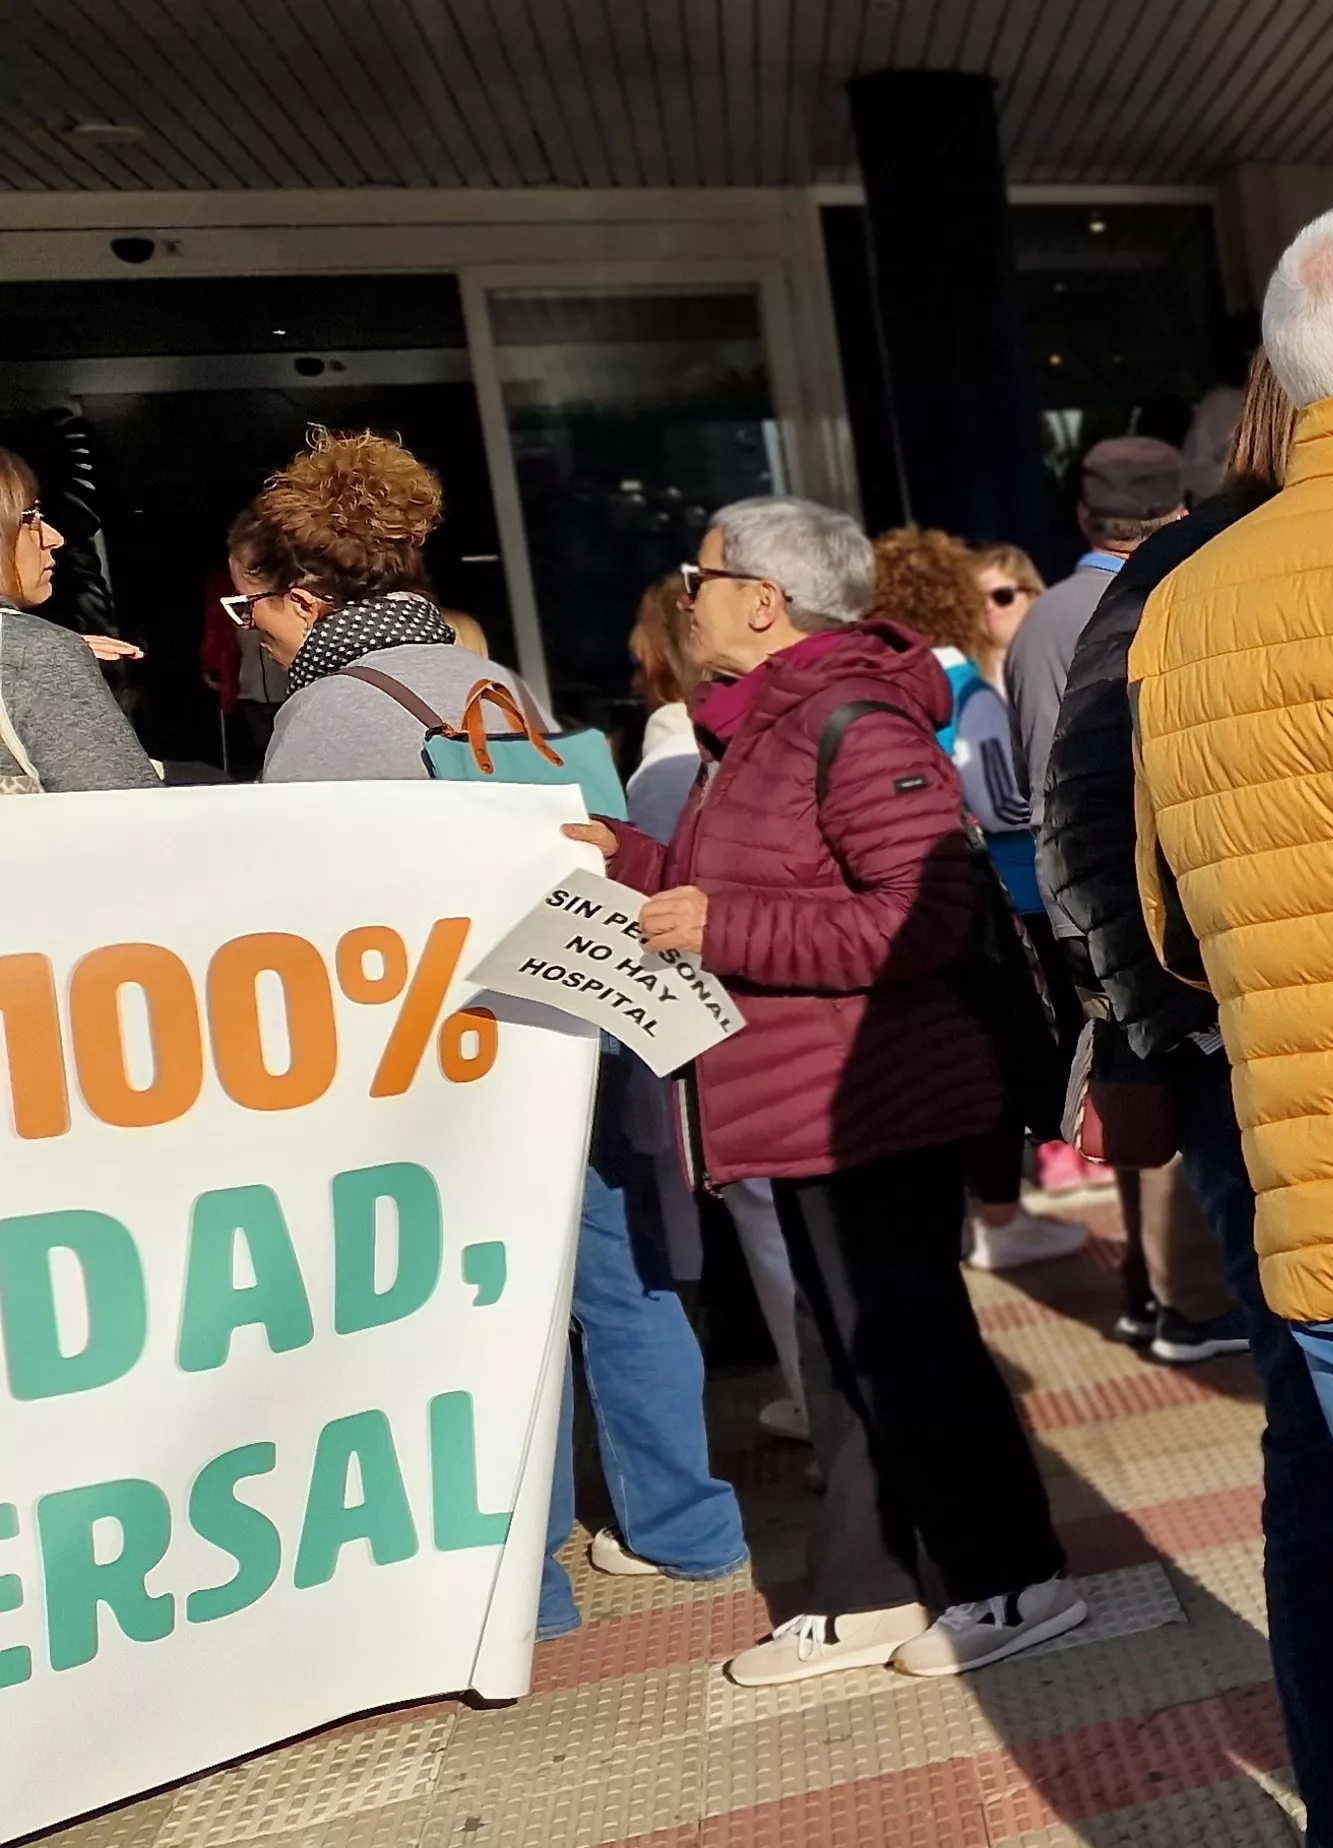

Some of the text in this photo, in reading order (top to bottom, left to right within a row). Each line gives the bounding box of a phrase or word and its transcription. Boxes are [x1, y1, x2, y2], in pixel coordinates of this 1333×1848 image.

[0, 917, 498, 1140] 100%
[517, 957, 661, 1038] HOSPITAL
[544, 889, 733, 1033] SIN PESONAL
[565, 935, 680, 1002] NO HAY
[0, 1161, 508, 1401] DAD,
